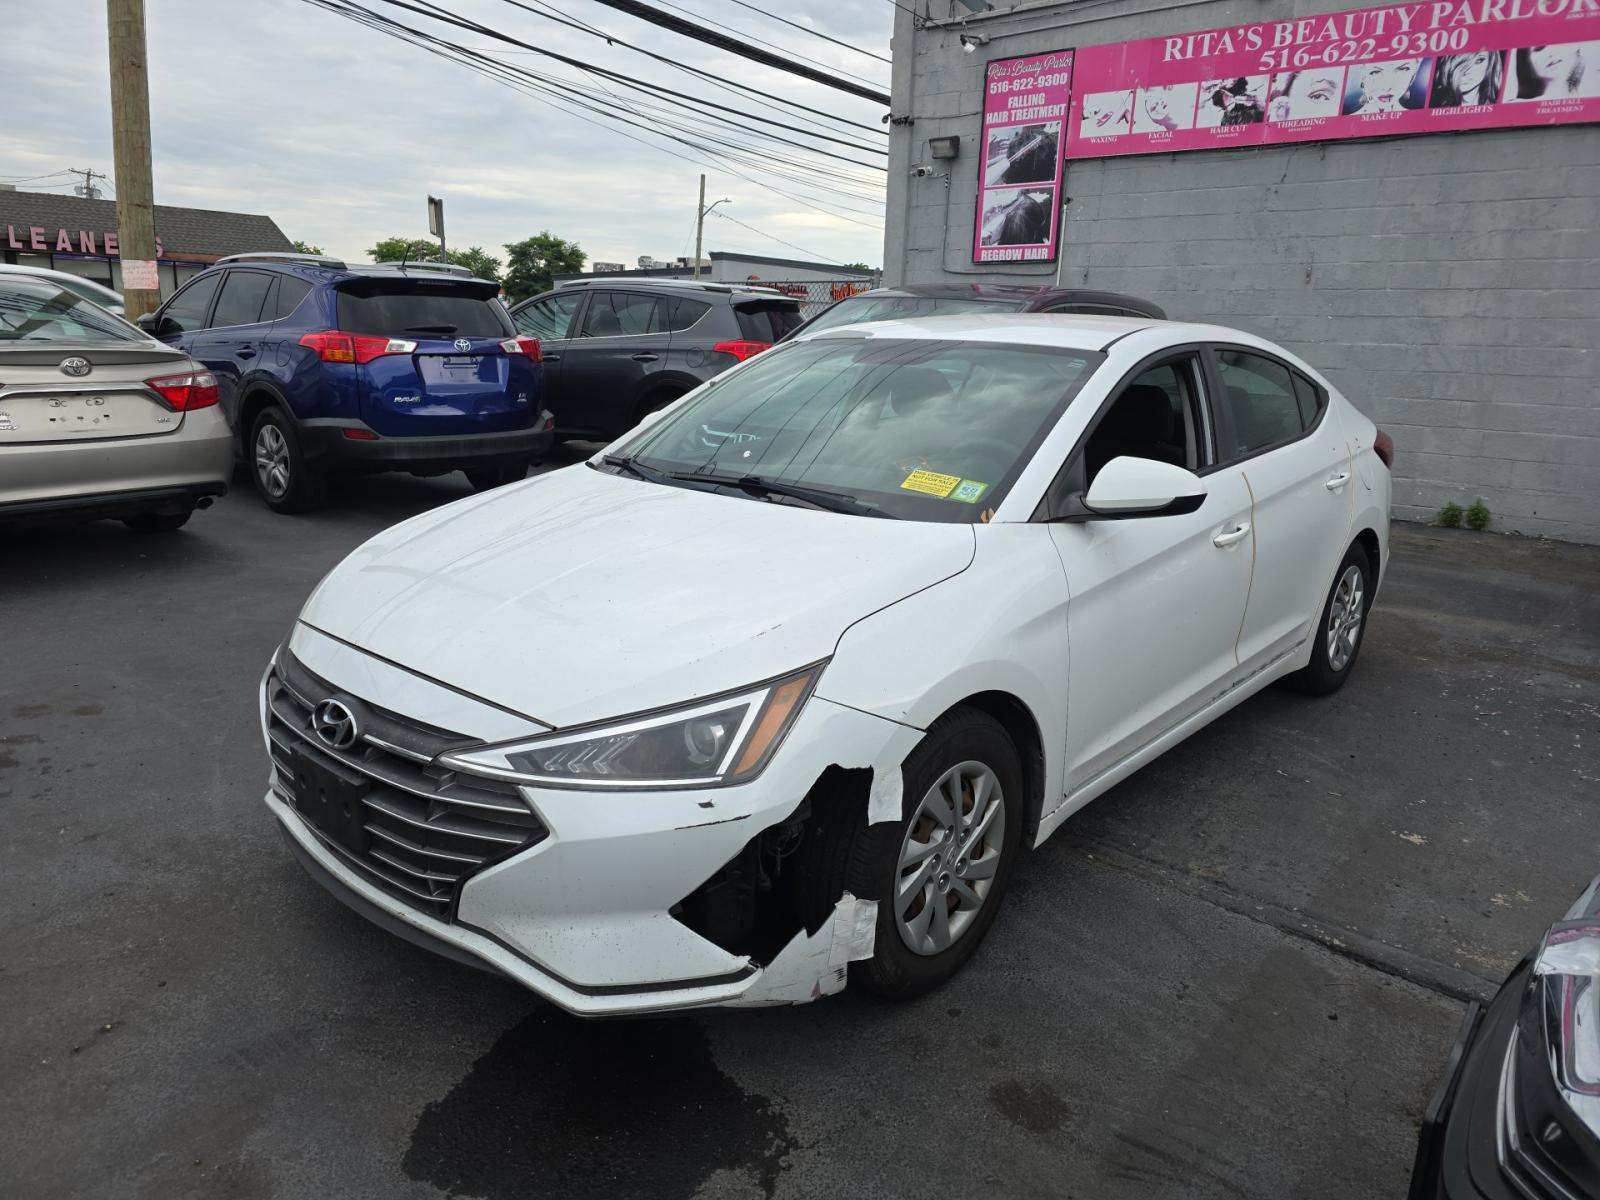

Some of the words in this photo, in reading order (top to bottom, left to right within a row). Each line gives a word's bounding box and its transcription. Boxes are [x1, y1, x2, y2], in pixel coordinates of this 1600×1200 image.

[1162, 26, 1264, 62] RITA'S
[1272, 5, 1426, 49] BEAUTY
[1258, 28, 1469, 71] 516-622-9300
[1011, 60, 1042, 77] Beauty
[1043, 53, 1073, 69] Parlor
[989, 72, 1068, 94] 516-622-9300
[1008, 93, 1046, 109] FALLING
[986, 111, 1009, 124] HAIR
[1010, 104, 1067, 121] TREATMENT
[1361, 113, 1388, 121] MAKE
[1390, 112, 1403, 120] UP
[1431, 105, 1494, 116] HIGHLIGHTS
[1210, 126, 1230, 134] HAIR
[1230, 124, 1248, 132] CUT
[1277, 117, 1326, 129] THREADING
[1090, 136, 1118, 144] WAXING
[1148, 131, 1174, 139] FACIAL
[981, 249, 1022, 261] REGROW
[1024, 248, 1049, 260] HAIR
